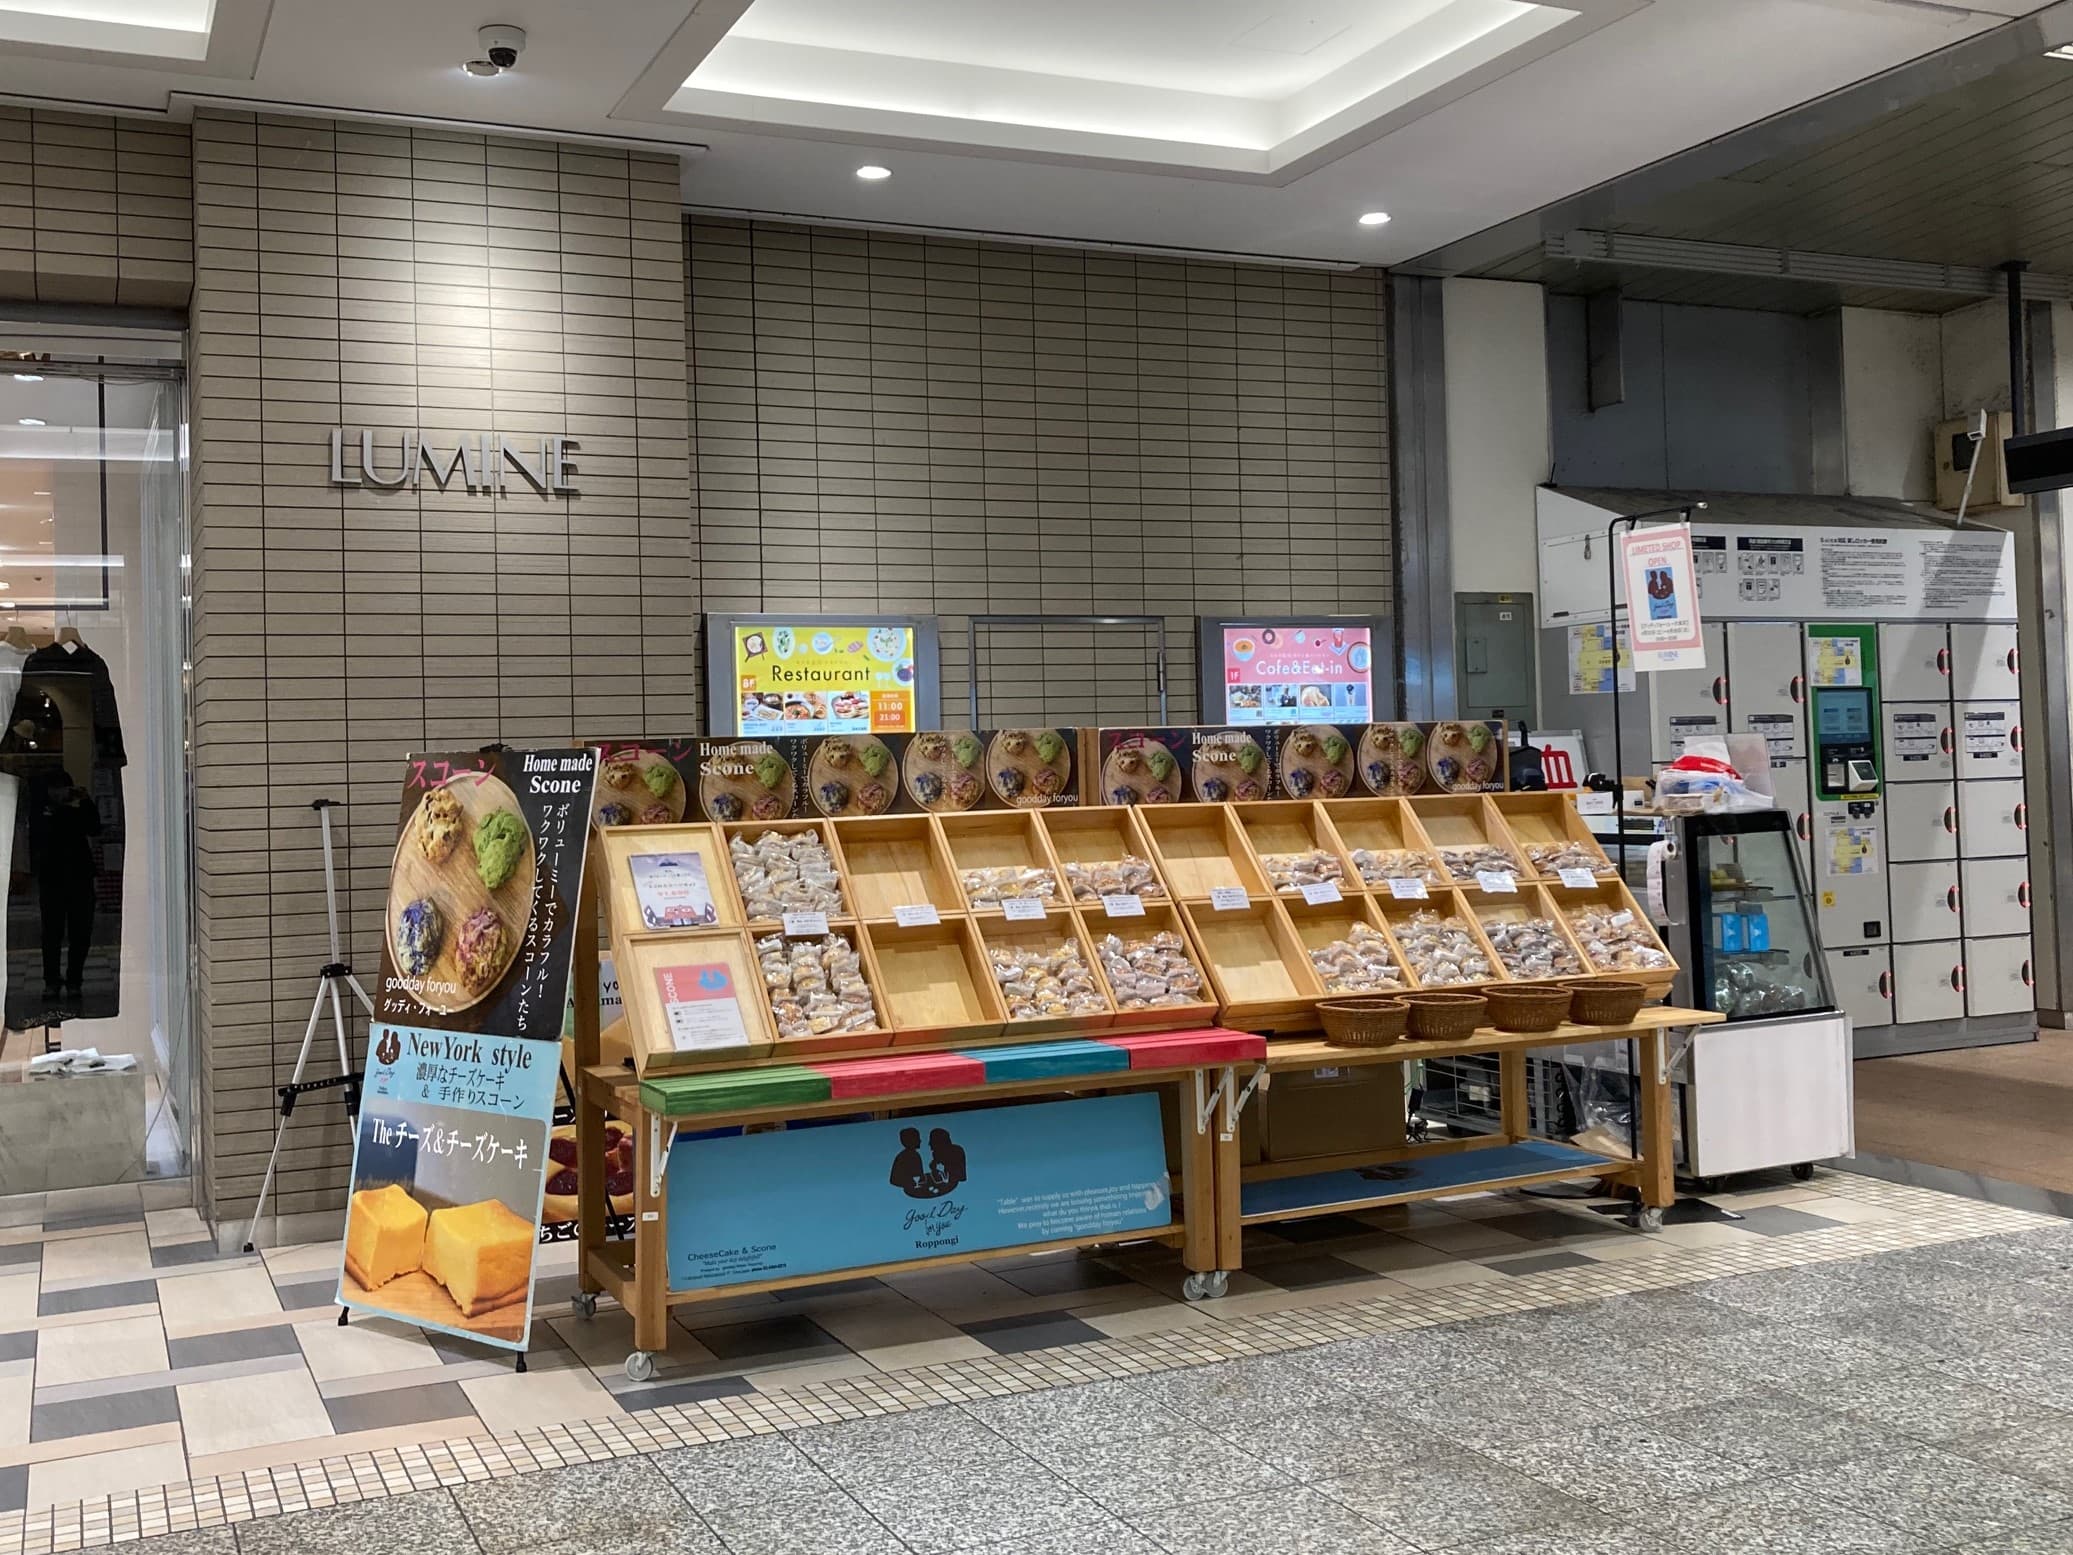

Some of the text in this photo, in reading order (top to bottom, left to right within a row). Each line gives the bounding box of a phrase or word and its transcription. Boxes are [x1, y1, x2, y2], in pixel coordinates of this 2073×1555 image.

[330, 428, 580, 494] LUMINE
[772, 665, 870, 682] Restaurant
[878, 702, 903, 711] 11:00
[1192, 731, 1252, 745] Home made
[700, 742, 773, 756] Home made
[1192, 749, 1237, 762] Scone
[523, 753, 593, 772] Home made
[700, 761, 755, 776] Scone
[408, 759, 496, 788] スコーン
[529, 775, 581, 793] Scone
[1016, 792, 1079, 807] goodday foryou
[517, 803, 553, 1031] ワクワクしてくるスコーンたち
[385, 977, 457, 994] goodday foryou
[491, 1047, 532, 1073] style
[416, 1062, 505, 1090] 濃厚なチーズケーキ
[439, 1087, 525, 1110] 手作りスコーン
[915, 1235, 960, 1249] Roppongi
[687, 1247, 740, 1262] CheeseCake
[741, 1246, 749, 1255] &
[751, 1243, 777, 1255] Scone
